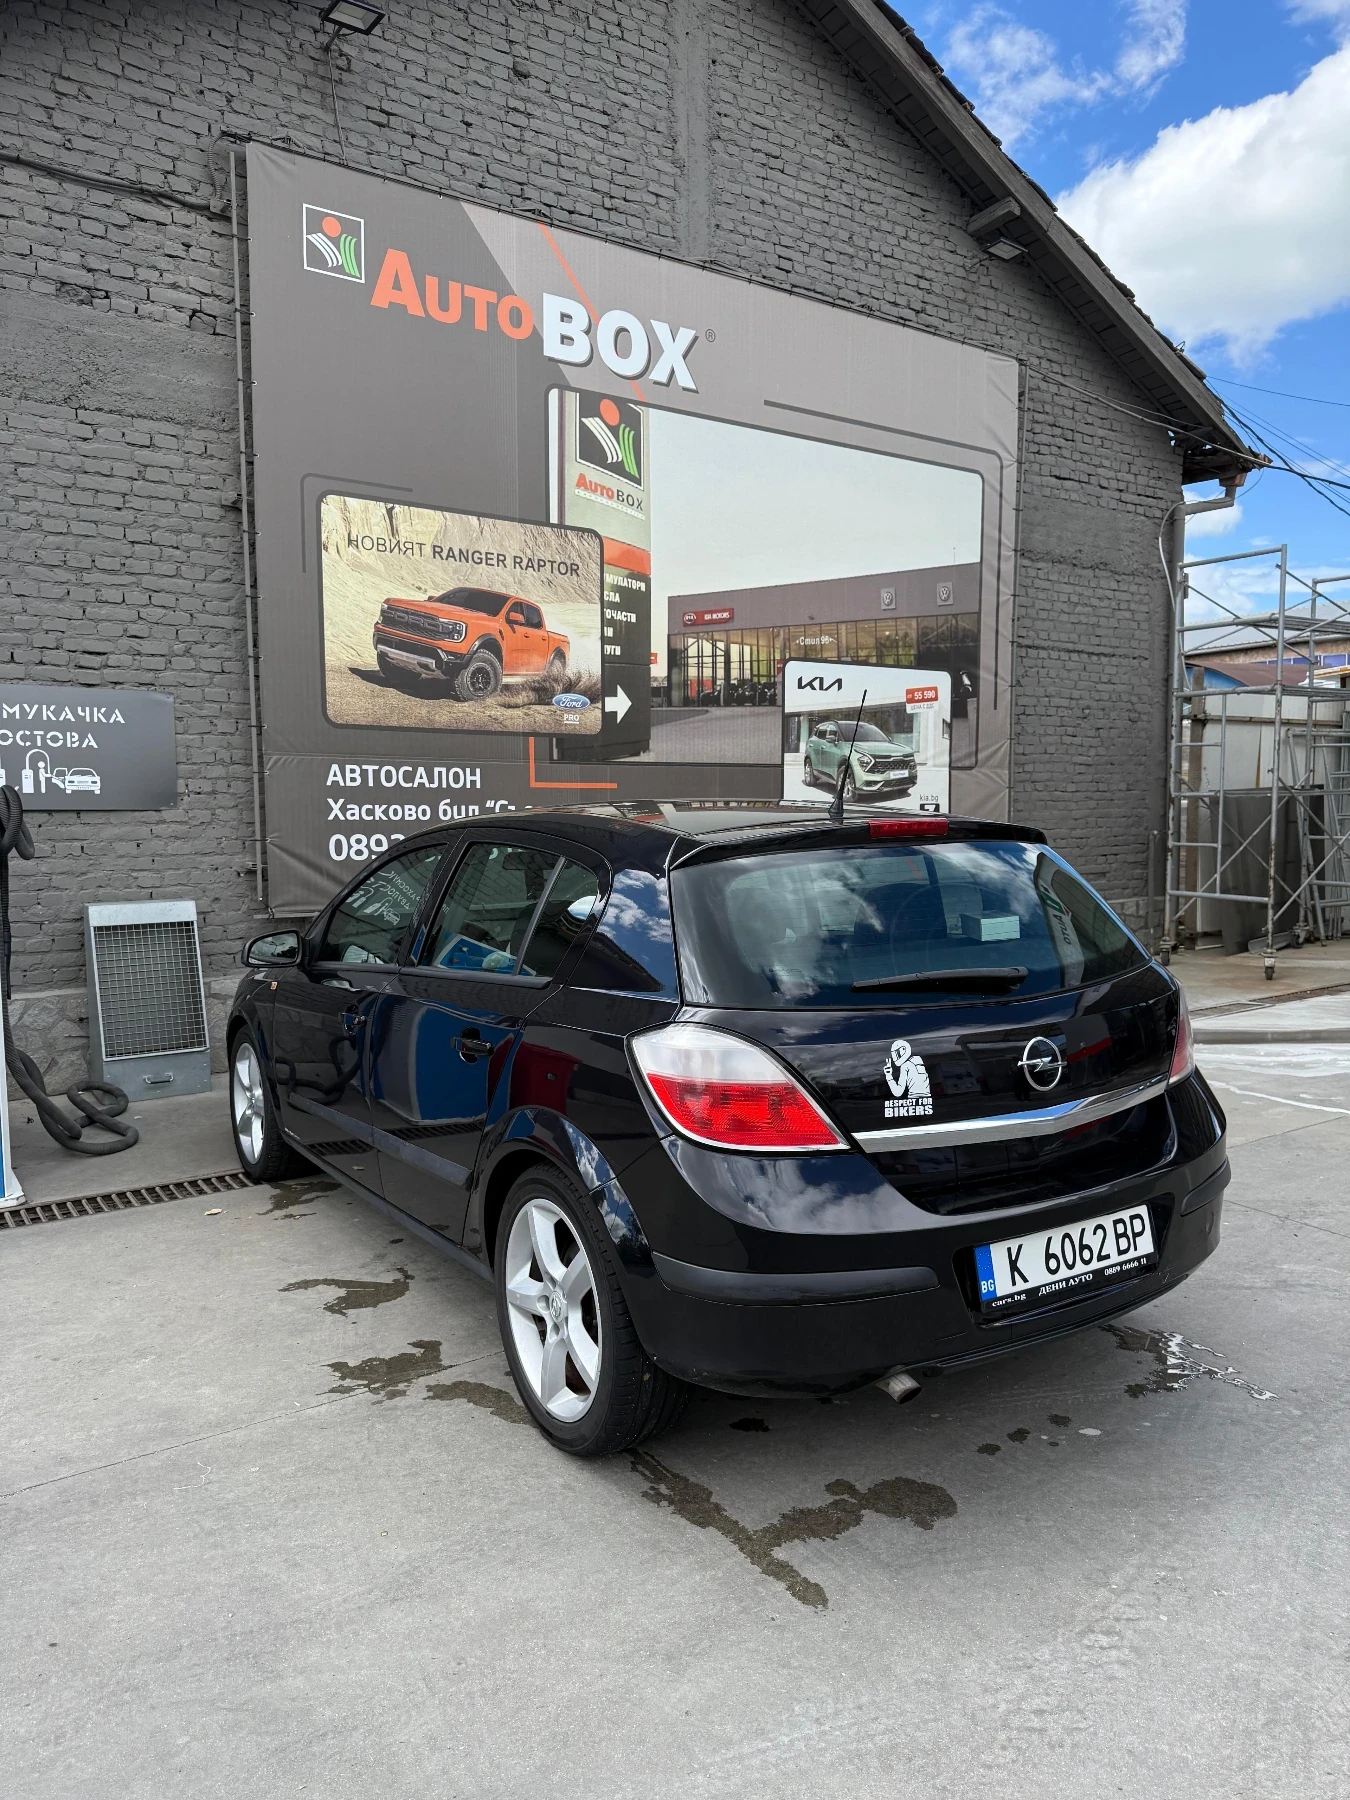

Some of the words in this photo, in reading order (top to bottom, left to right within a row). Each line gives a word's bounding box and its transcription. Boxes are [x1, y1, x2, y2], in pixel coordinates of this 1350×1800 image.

[347, 532, 426, 557] НОВИЯТ
[432, 544, 507, 569] RANGER
[513, 555, 580, 577] RAPTOR
[797, 675, 843, 692] KIA
[559, 695, 584, 708] Ford
[914, 691, 923, 700] 55
[923, 690, 936, 699] 590
[2, 702, 126, 724] МУКАЧКА
[563, 713, 580, 721] PRO
[0, 729, 99, 749] ОСТОВА
[326, 763, 481, 789] АВТОСАЛОН
[919, 794, 940, 803] kia.bg
[327, 798, 431, 821] Хасково
[884, 1098, 917, 1108] RESPECT
[918, 1097, 933, 1105] FOR
[884, 1105, 934, 1118] BIKERS
[1104, 1265, 1121, 1276] 0889
[1122, 1260, 1139, 1271] 6666
[981, 1279, 995, 1294] BG
[1038, 1280, 1067, 1297] ДЕНИ
[1068, 1273, 1093, 1287] АУТО
[991, 1293, 1027, 1307] cars.bg
